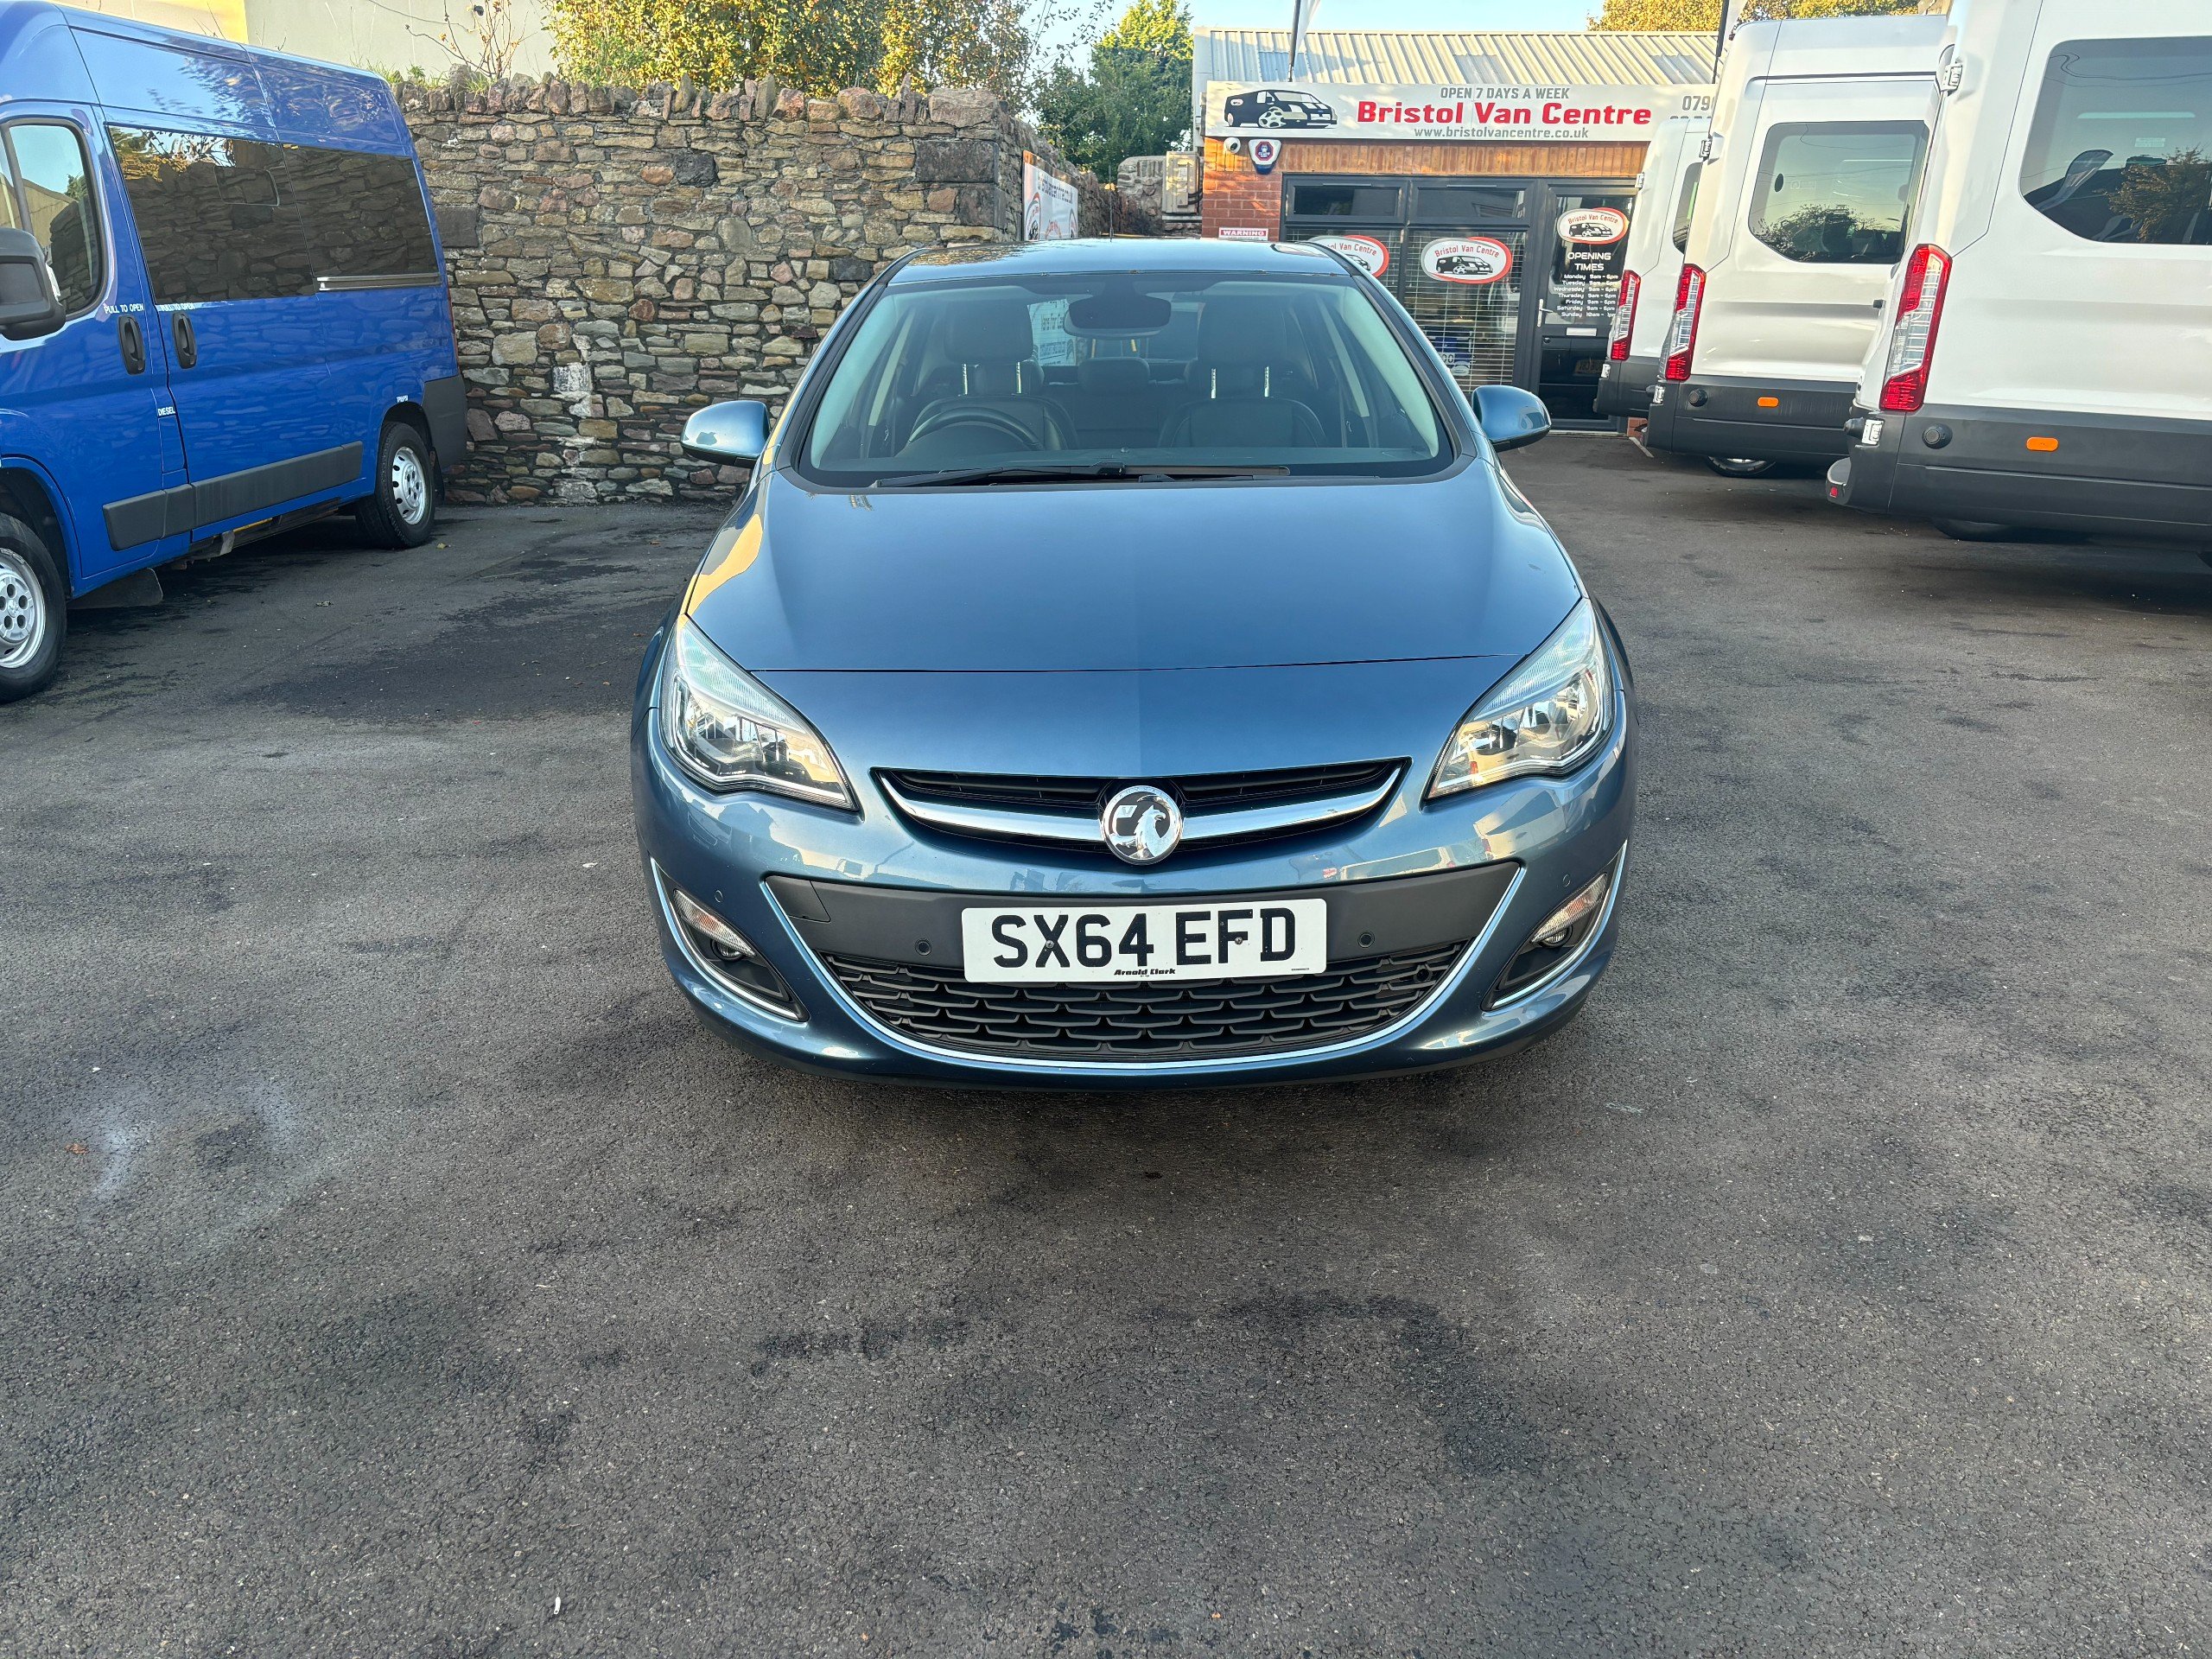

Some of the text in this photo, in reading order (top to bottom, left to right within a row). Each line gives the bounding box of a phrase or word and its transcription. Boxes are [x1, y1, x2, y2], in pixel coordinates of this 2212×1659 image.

[1440, 87, 1570, 99] OPEN 7 DAYS A WEEK
[1682, 96, 1715, 111] 079
[1357, 100, 1651, 124] Bristol Van Centre
[1414, 126, 1588, 138] www.bristolvancentre.co.uk
[1568, 214, 1586, 224] Bristol
[1600, 214, 1618, 224] Centre
[1354, 244, 1377, 256] Centre
[1434, 245, 1459, 257] Bristol
[1476, 245, 1499, 257] Centre
[158, 407, 175, 416] DIESEL
[991, 907, 1295, 969] SX64 EFD
